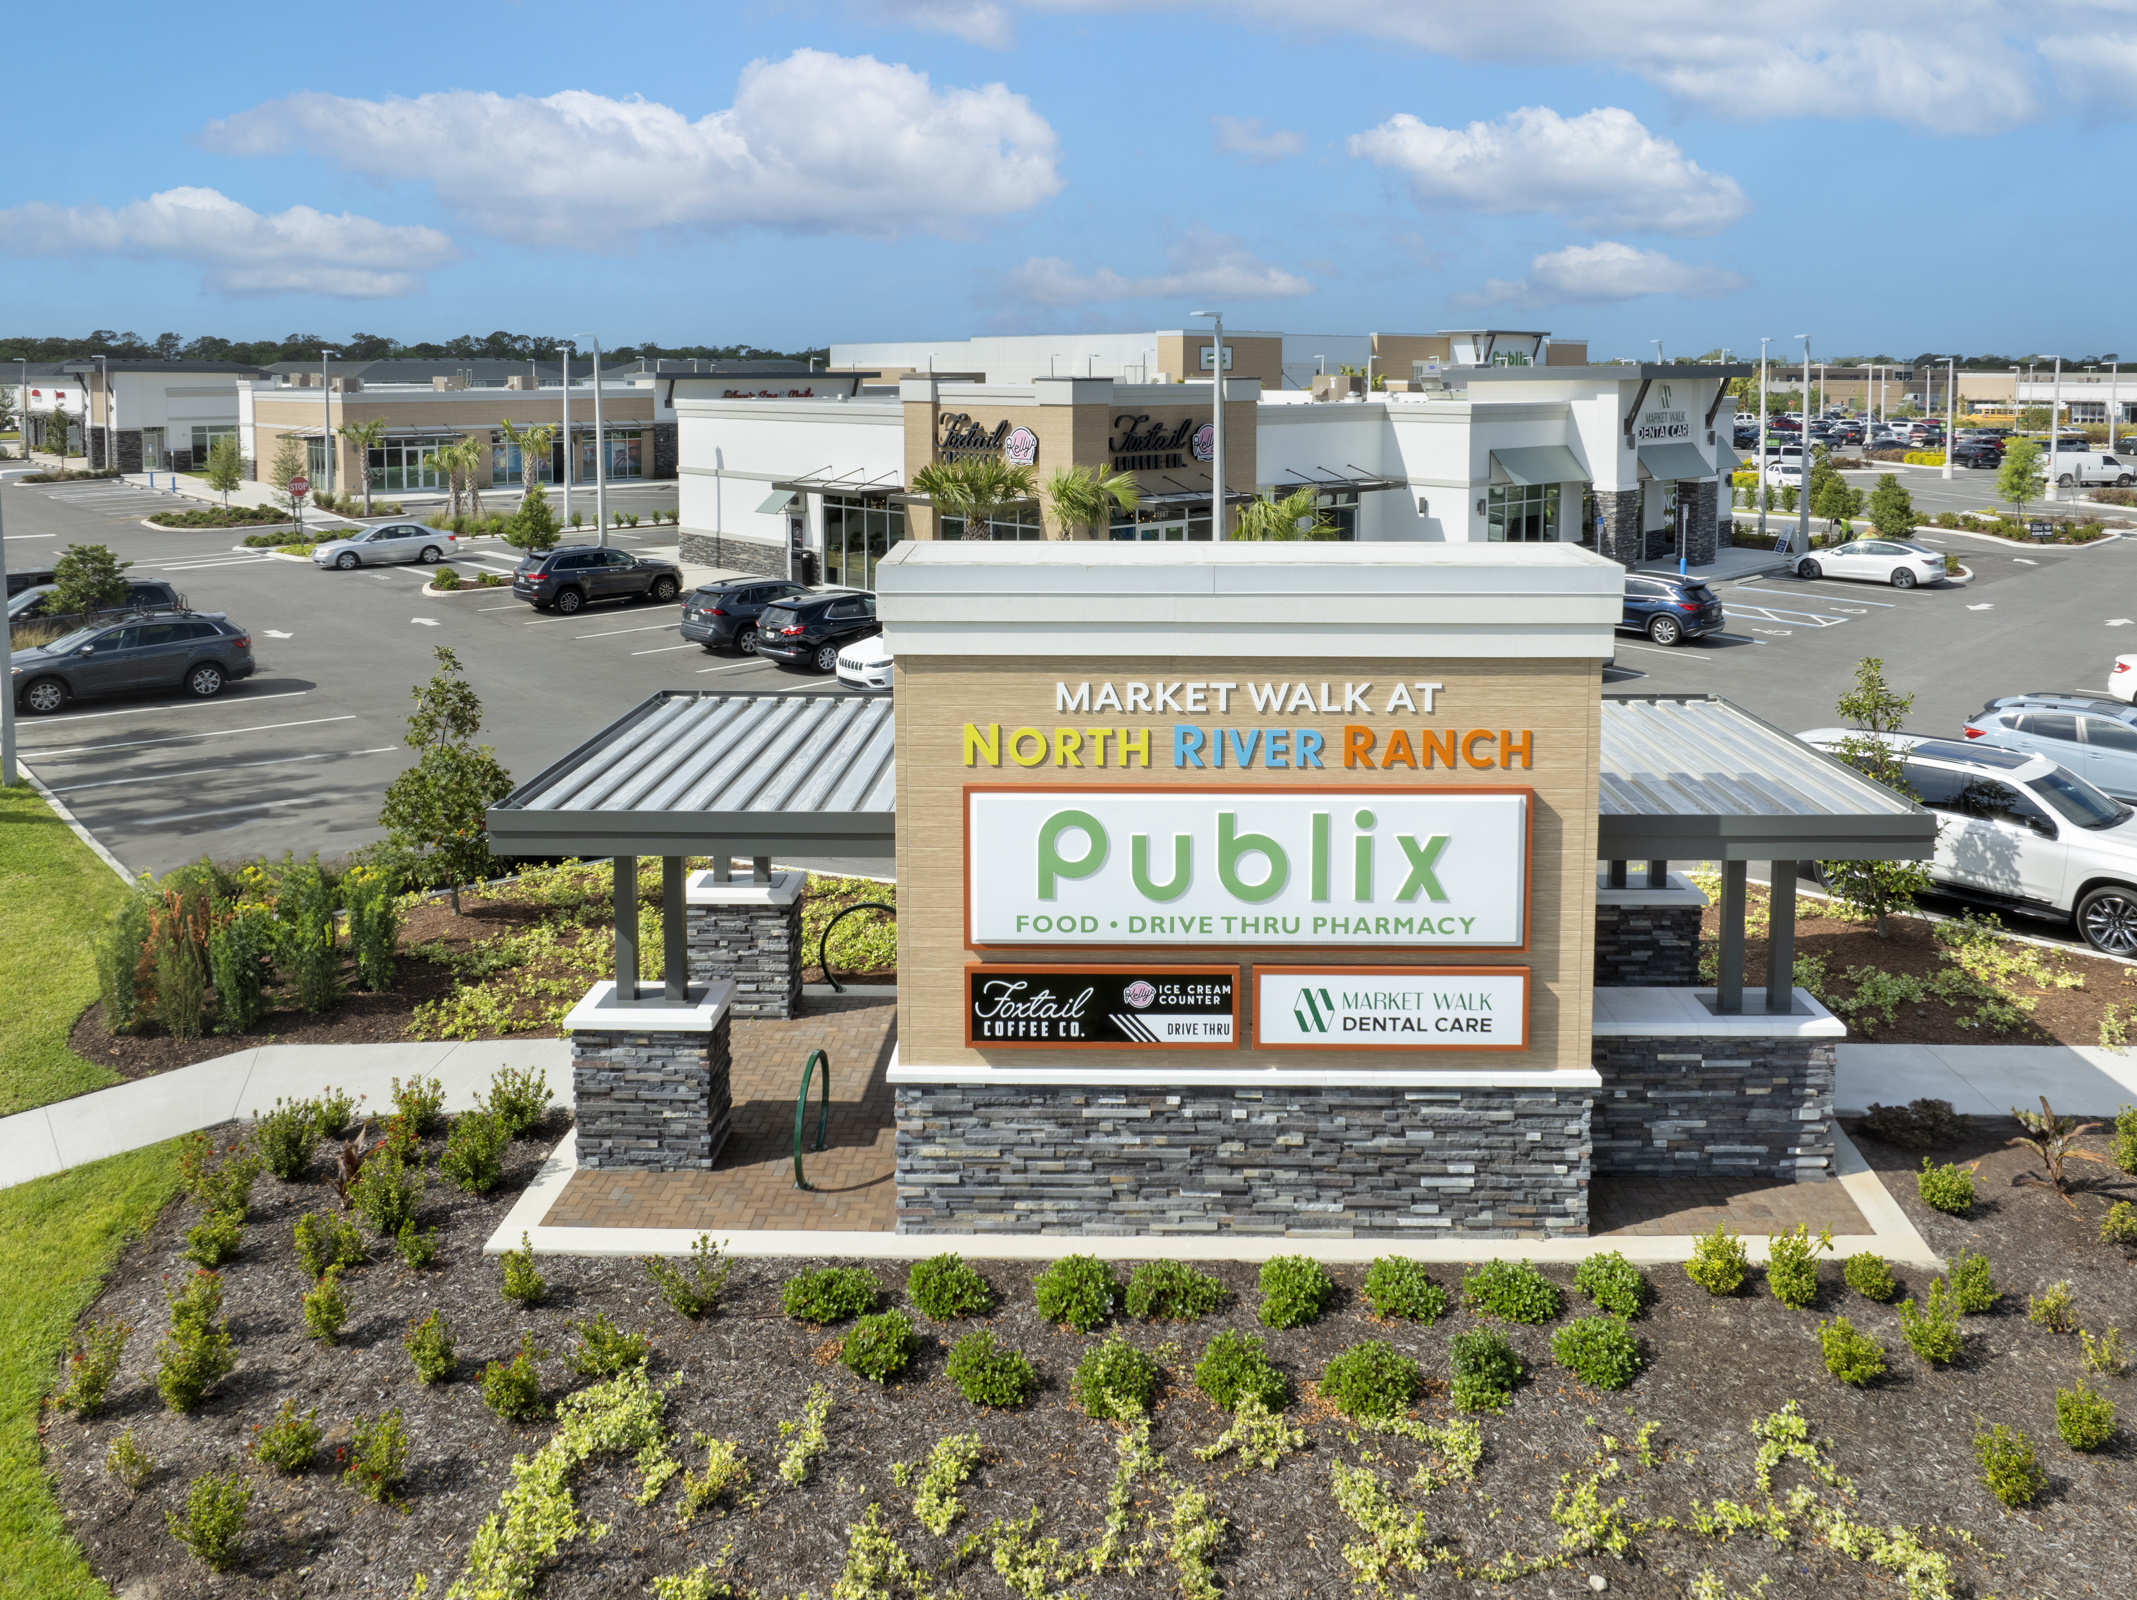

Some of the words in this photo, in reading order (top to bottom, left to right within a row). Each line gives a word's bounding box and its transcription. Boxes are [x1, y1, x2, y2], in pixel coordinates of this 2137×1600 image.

[1492, 351, 1528, 366] Publix
[1645, 412, 1668, 424] MARKET
[1669, 411, 1686, 422] WALK
[933, 412, 1009, 450] Foxtail
[1108, 414, 1193, 453] Foxtail
[1638, 425, 1669, 439] DENTAL
[1671, 424, 1692, 437] CARE
[1114, 454, 1162, 472] COFFEE
[289, 482, 308, 491] STOP
[1055, 682, 1237, 712] MARKET
[1247, 682, 1374, 712] WALK
[1385, 682, 1443, 712] AT
[962, 723, 1151, 767] NORTH
[1172, 724, 1325, 768] RIVER
[1343, 725, 1533, 768] RANCH
[1036, 807, 1453, 903] Publix
[1015, 914, 1100, 934] FOOD
[1128, 915, 1214, 935] DRIVE
[1220, 916, 1301, 935] THRU
[1312, 916, 1477, 936] PHARMACY
[1158, 984, 1180, 995] ICE
[1187, 984, 1232, 995] CREAM
[975, 980, 1094, 1019] Foxtail
[1158, 995, 1221, 1005] COUNTER
[1342, 991, 1425, 1011] MARKET
[1432, 992, 1493, 1011] WALK
[983, 1020, 1050, 1037] COFFEE
[1058, 1021, 1086, 1037] CO.
[1167, 1023, 1200, 1036] DRIVE
[1202, 1023, 1231, 1036] THRU
[1342, 1016, 1429, 1032] DENTAL
[1434, 1017, 1493, 1033] CARE
